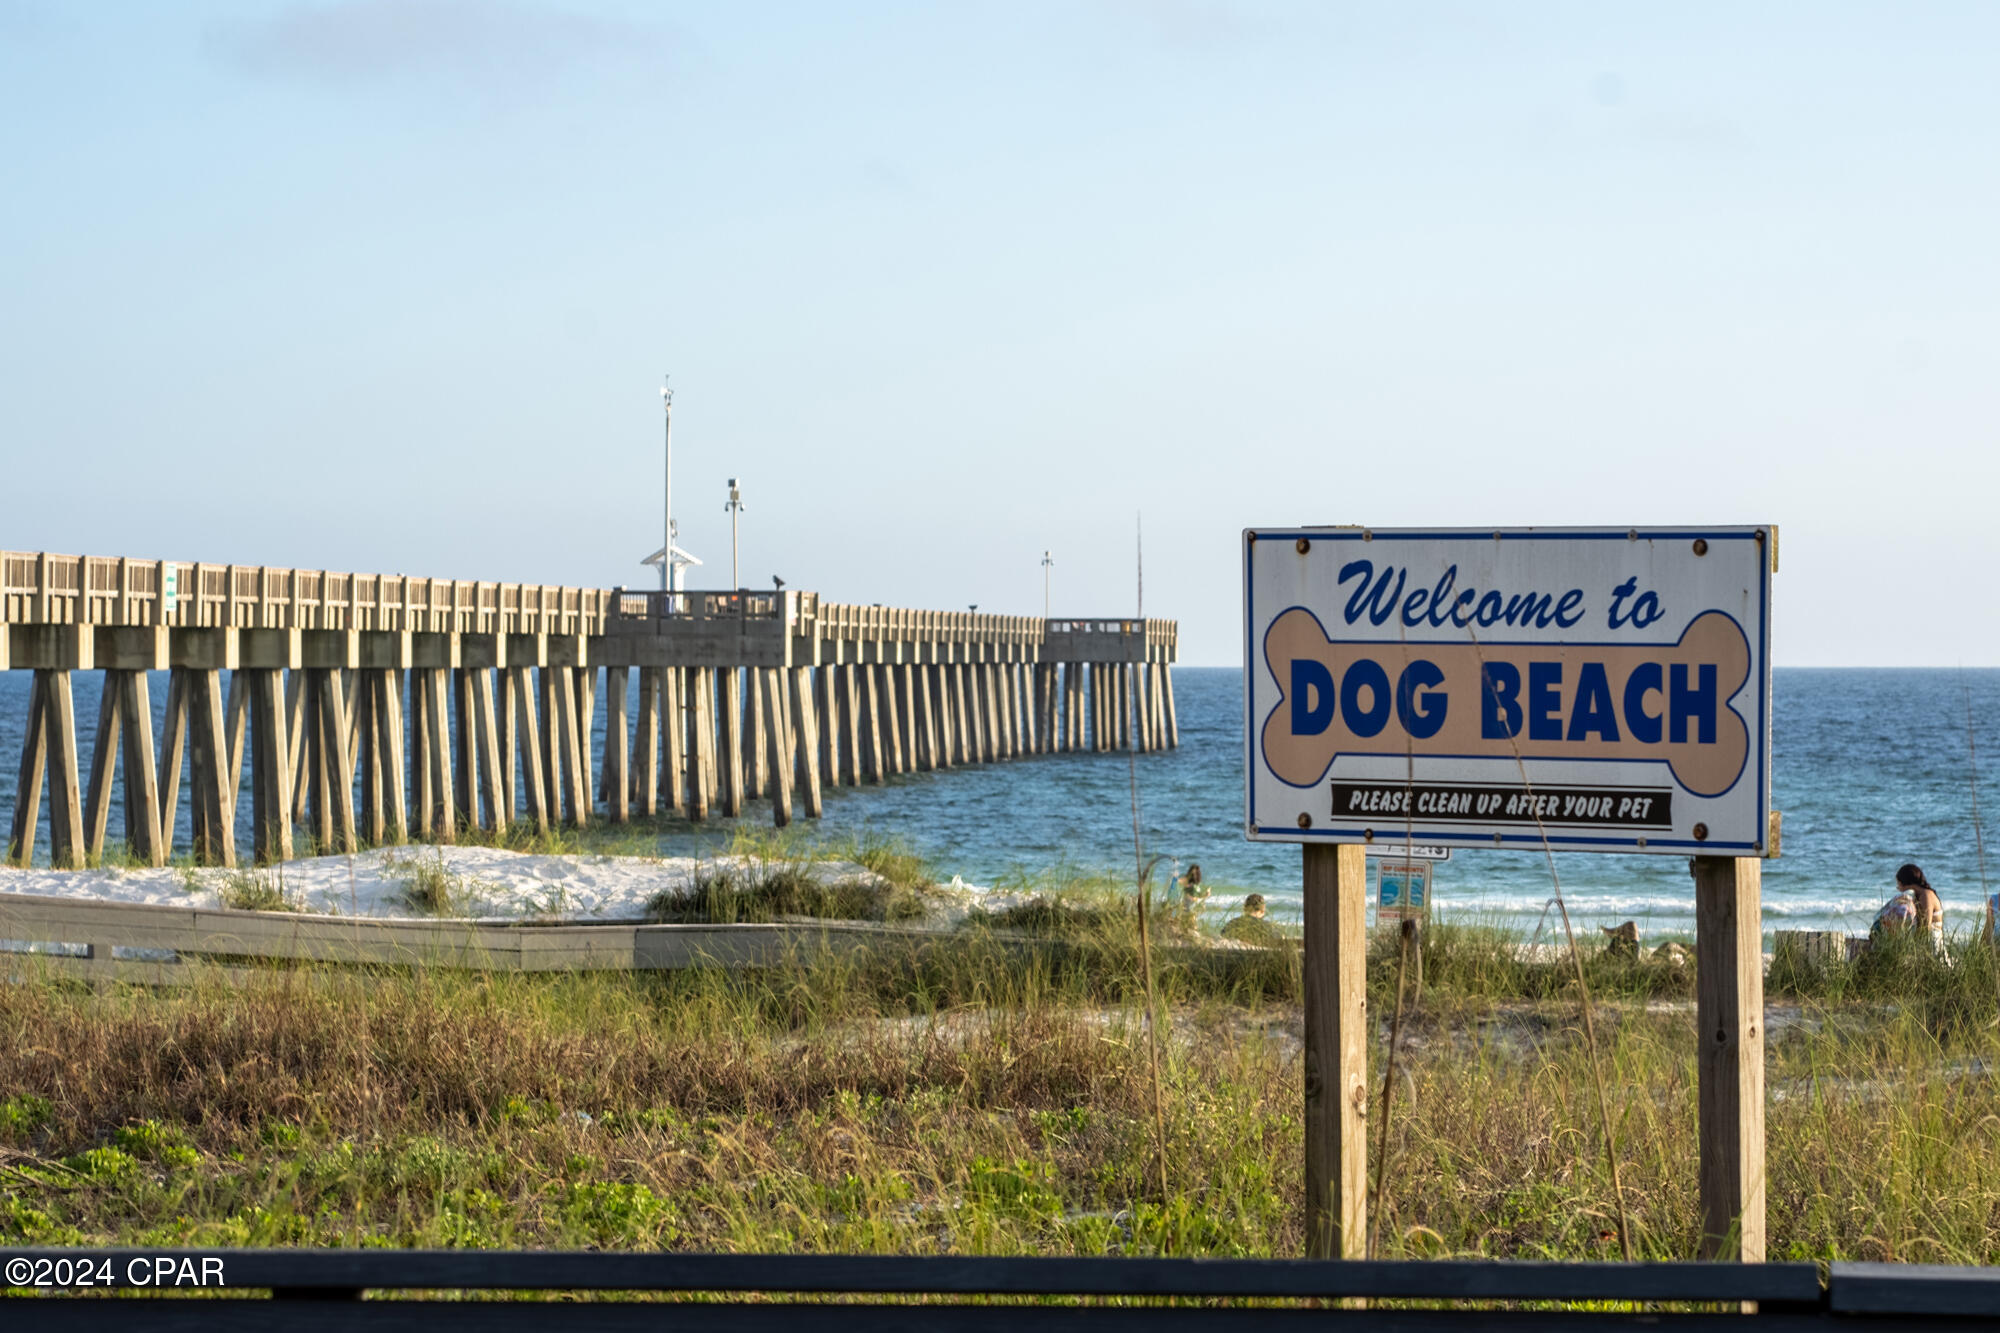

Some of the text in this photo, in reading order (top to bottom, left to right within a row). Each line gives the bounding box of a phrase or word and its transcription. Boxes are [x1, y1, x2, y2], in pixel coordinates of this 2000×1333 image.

[1338, 559, 1666, 630] Welcome to
[1291, 659, 1717, 744] DOG BEACH
[1349, 790, 1653, 819] PLEASE CLEAN UP AFTER YOUR PET
